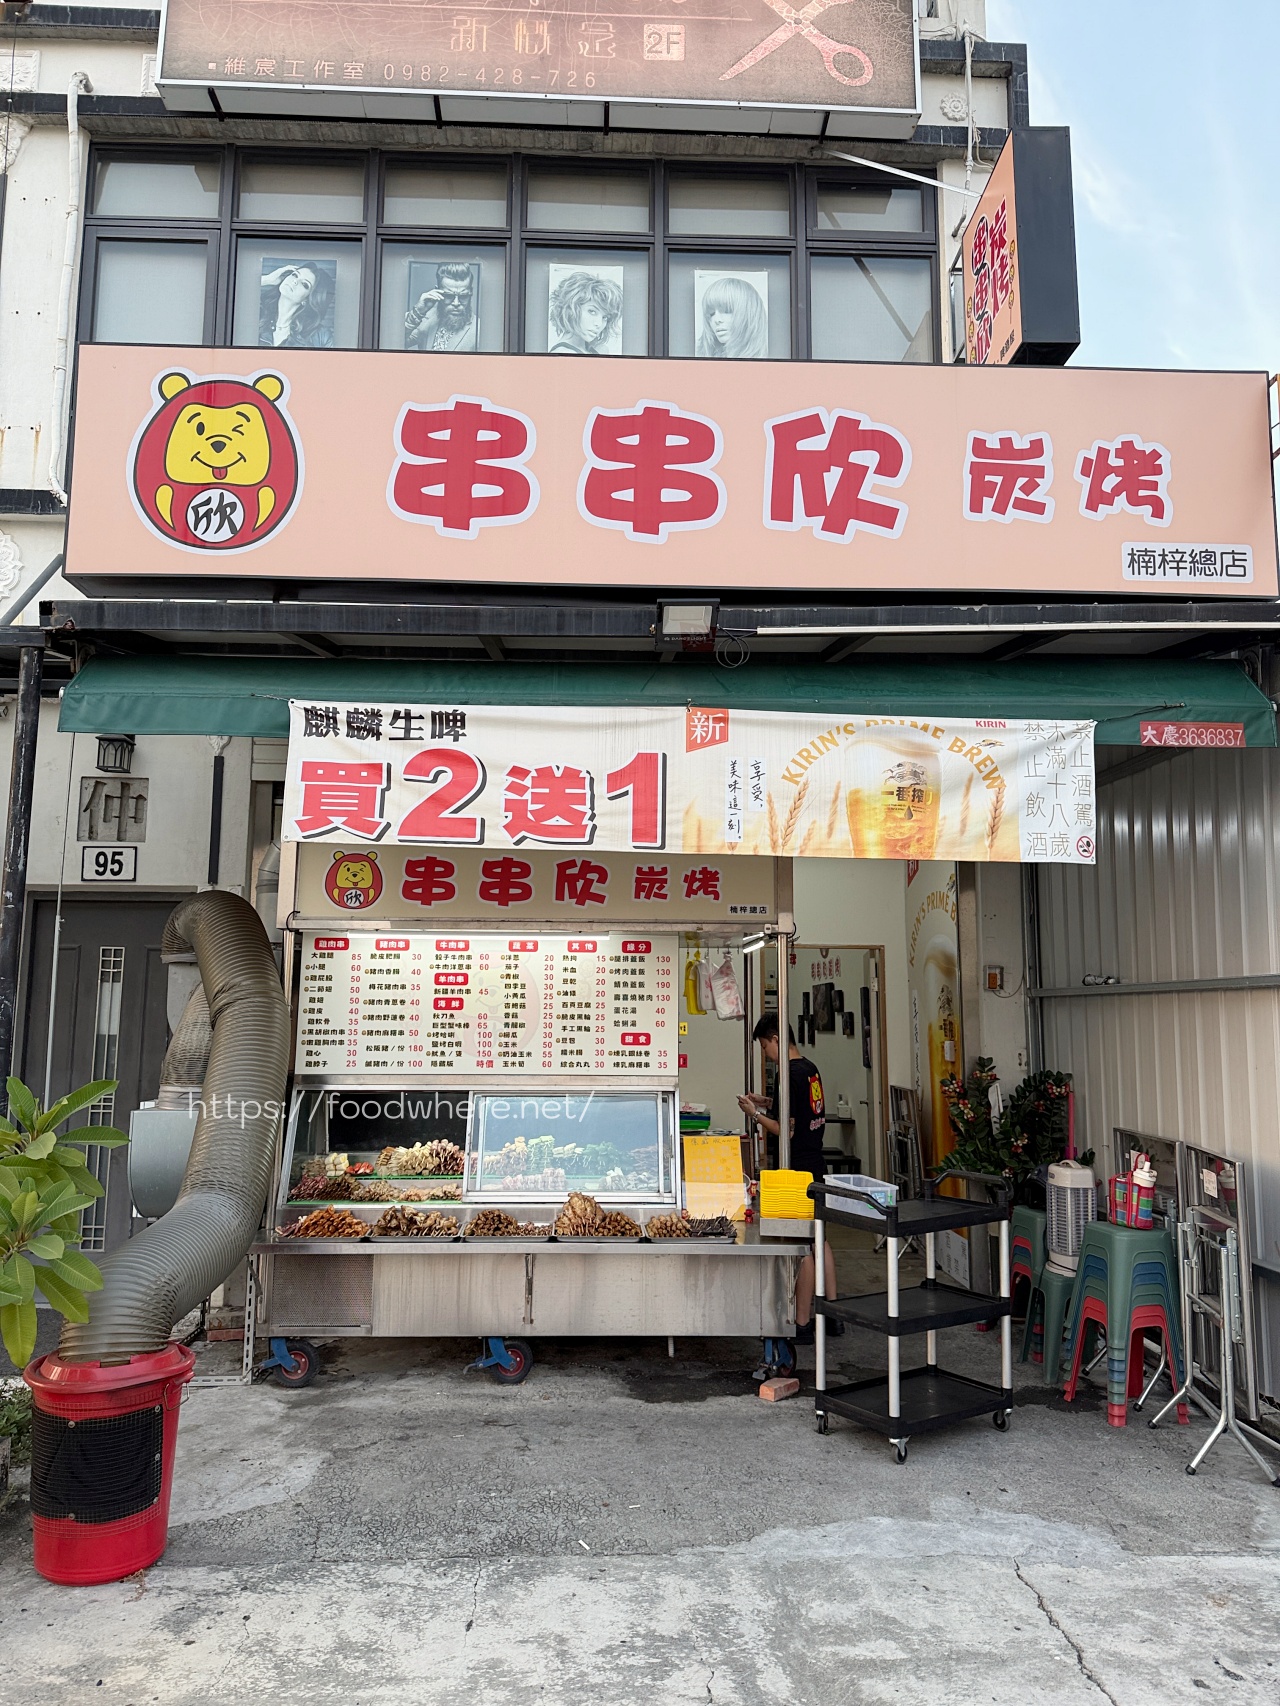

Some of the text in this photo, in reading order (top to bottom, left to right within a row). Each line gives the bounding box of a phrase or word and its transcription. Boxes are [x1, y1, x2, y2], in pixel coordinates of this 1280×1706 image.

[450, 15, 682, 58] 新概念 2F
[224, 56, 597, 88] 維宸工作室 0982-428-726
[989, 198, 1009, 320] 炭烤
[390, 398, 1168, 538] 串串欣炭烤
[191, 495, 239, 537] 欣
[1126, 546, 1249, 578] 楠梓總店
[303, 706, 467, 743] 麒麟生啤
[690, 711, 725, 744] 新
[975, 719, 1007, 729] KIRIN
[781, 722, 1007, 792] KIRIN'S BREW
[1070, 722, 1092, 827] 禁止酒駕
[1024, 722, 1048, 858] 禁止飲酒
[1046, 722, 1072, 858] 未滿十八歲
[294, 749, 665, 848] 買2送1
[83, 780, 147, 841] 仲
[94, 851, 124, 877] 95
[401, 855, 721, 907] 串串欣炭烤
[729, 905, 768, 915] 楠梓總店
[909, 902, 927, 969] KIRIN'S
[926, 890, 950, 915] PRIME
[319, 940, 345, 948] 雞肉串
[379, 940, 406, 949] 豬肉串
[439, 941, 466, 949] 牛肉串
[512, 941, 534, 950] 蔬菜
[571, 942, 594, 951] 其他
[562, 954, 577, 962] 熱狗
[310, 963, 361, 972] 小腿 60
[350, 975, 361, 983] 50
[439, 975, 464, 983] 羊肉串
[350, 986, 360, 994] 50
[437, 1000, 460, 1008] 海鮮
[308, 1007, 323, 1015] 雞皮
[307, 1018, 330, 1026] 雞軟骨
[625, 1035, 647, 1043] 甜食
[476, 1060, 494, 1068] 時價
[502, 1060, 525, 1068] 玉米筍
